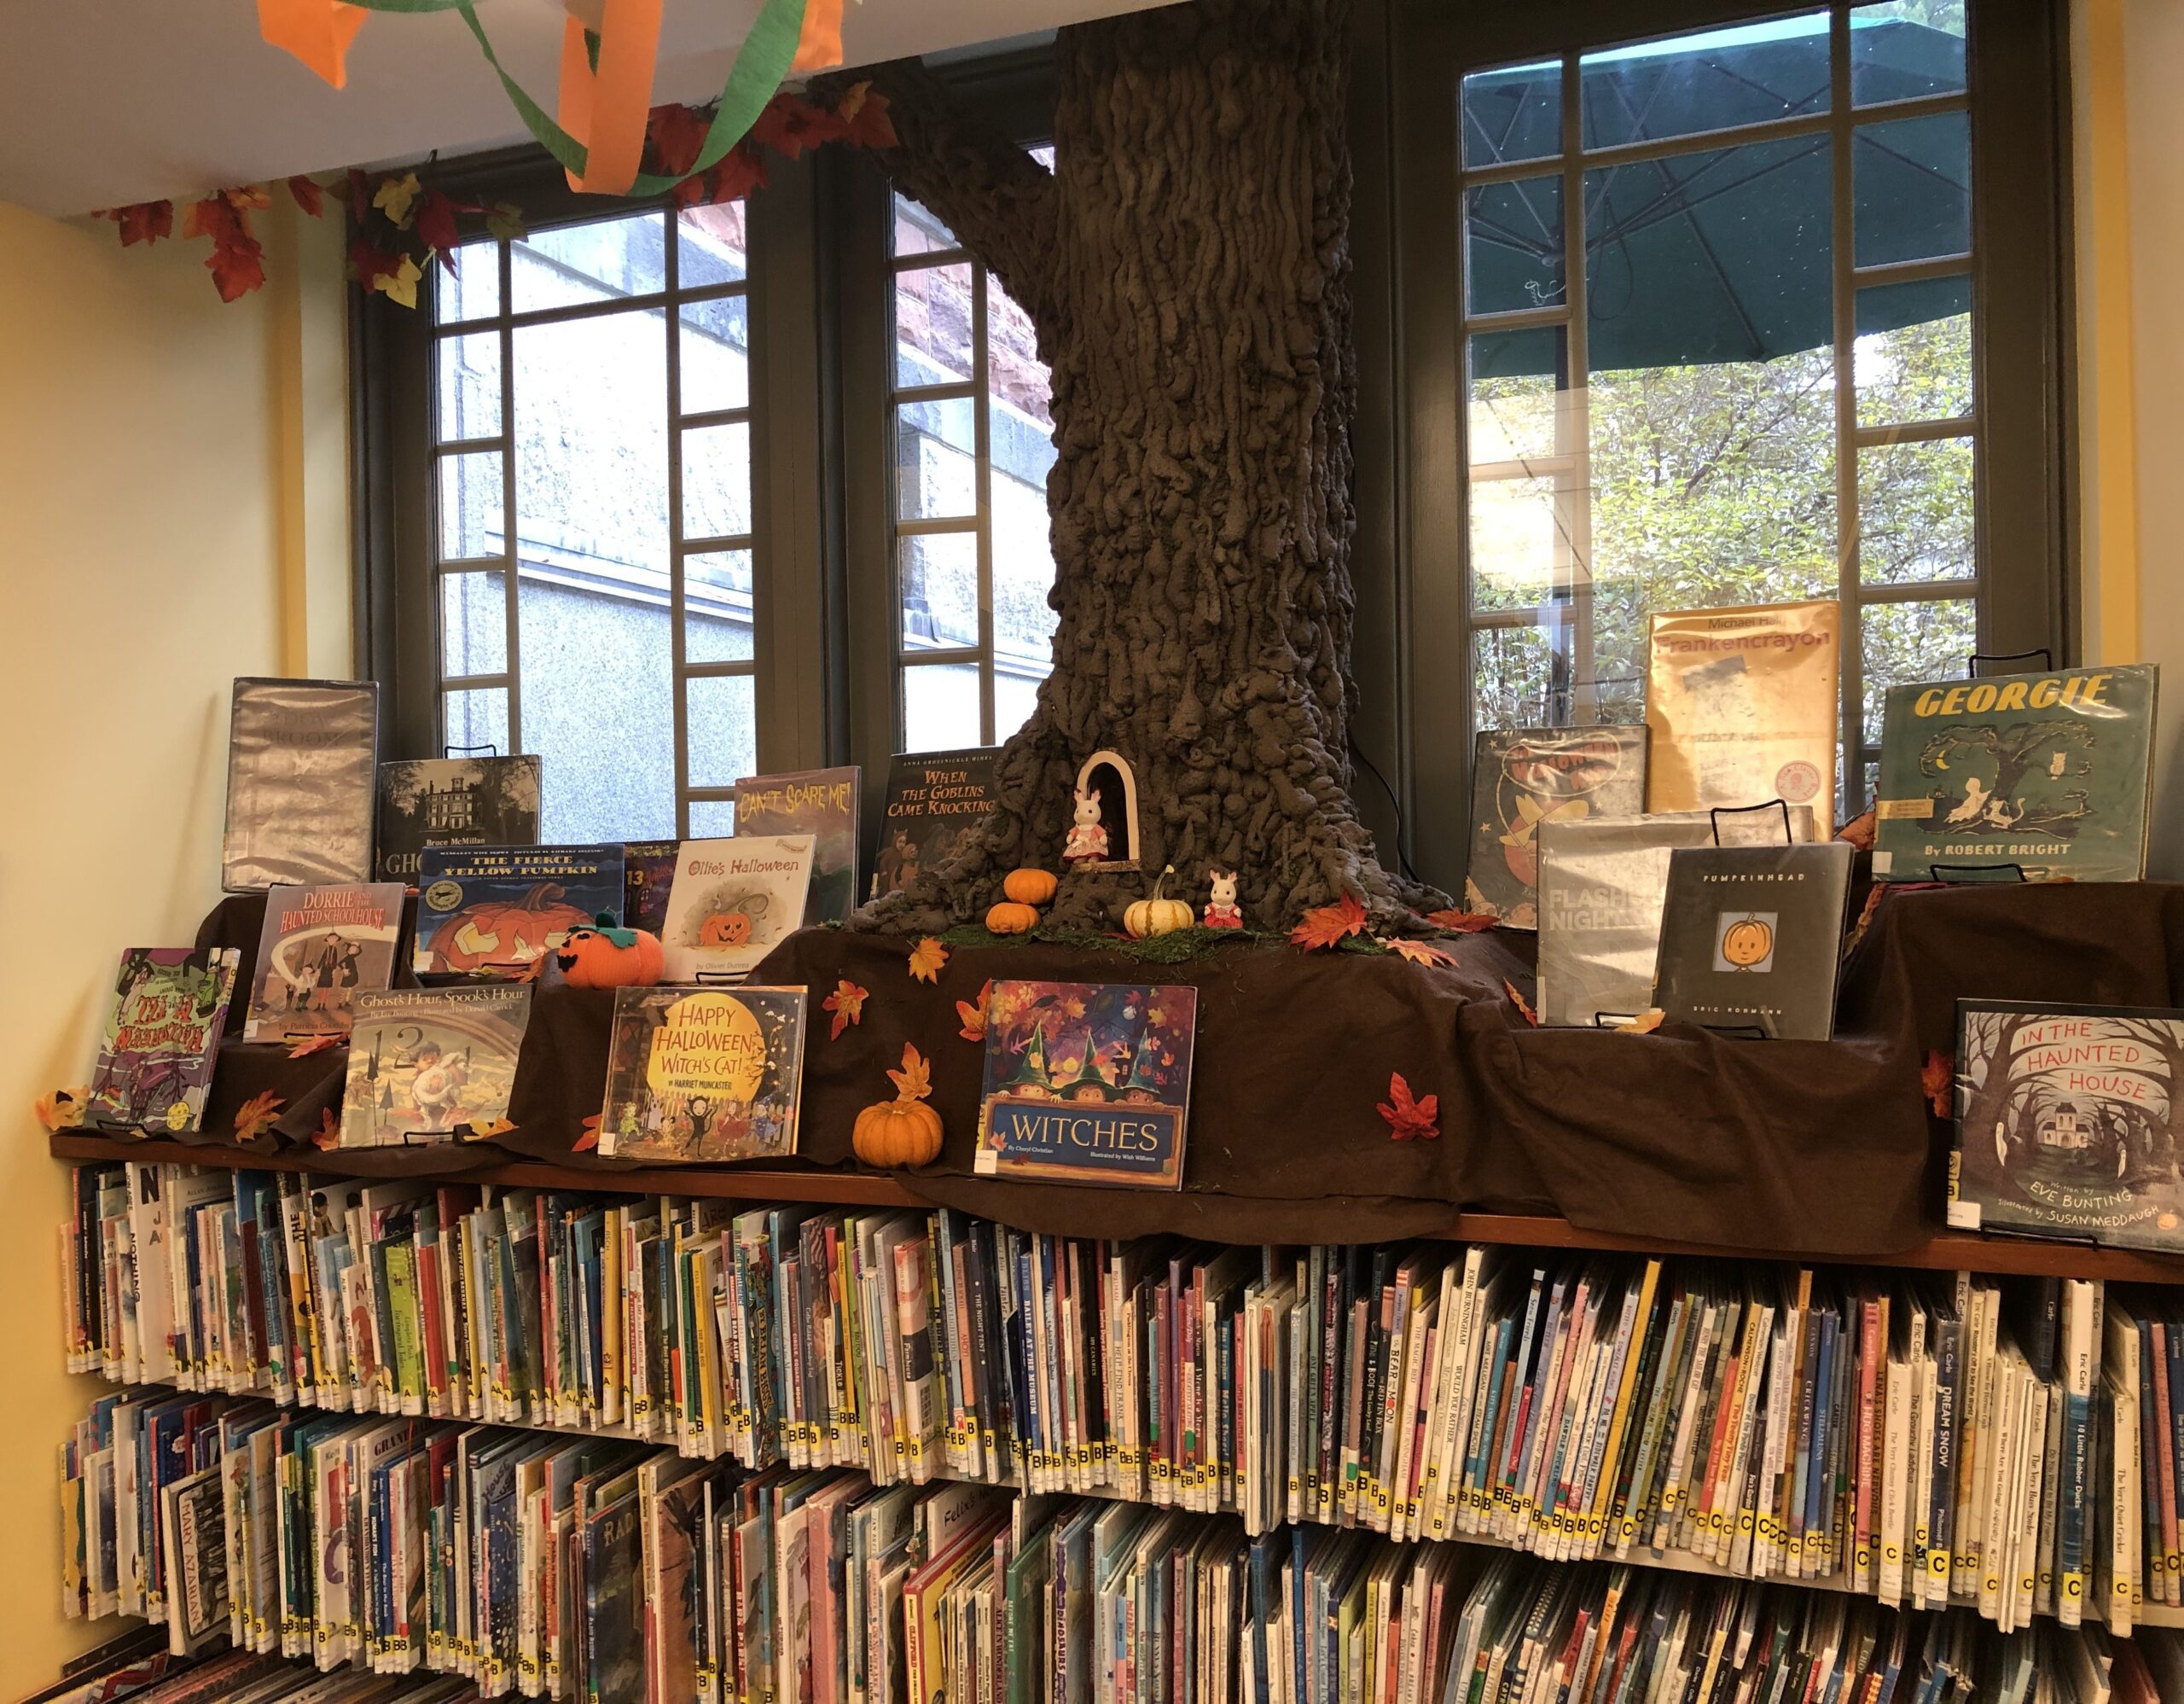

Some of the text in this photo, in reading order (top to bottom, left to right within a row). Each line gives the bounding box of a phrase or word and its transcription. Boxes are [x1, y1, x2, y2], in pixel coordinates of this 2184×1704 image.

[1708, 617, 1755, 629] Michael
[1656, 631, 1830, 653] Frankencrayon
[1914, 674, 2114, 718] GEORGIE
[924, 771, 967, 784] WHEN
[785, 783, 826, 814] SCARE
[828, 782, 851, 814] ME!
[902, 785, 985, 801] THE GOBLINS
[887, 800, 996, 817] CAME KNOCKING
[471, 857, 508, 865] THE
[1925, 844, 2071, 857] By ROBERT BRIGHT
[444, 865, 597, 876] YELLOW PUMPKIN
[627, 870, 643, 885] 13
[688, 860, 725, 876] Ollie's
[730, 858, 799, 875] Halloween
[1703, 874, 1805, 882] PUMPKINHEAD
[304, 891, 355, 909] DORRIE
[280, 908, 386, 933] HAUNTED SCHOOLHOUSE
[361, 988, 525, 1008] Ghost's Hour, Spook's Hour
[678, 1002, 736, 1027] HAPPY
[2022, 1022, 2094, 1044] IN THE
[662, 1053, 742, 1075] WITCH'S CAT!
[2027, 1044, 2140, 1072] HAUNTED
[675, 1079, 698, 1089] HARRIET
[699, 1080, 732, 1090] MUNCASTER
[2070, 1073, 2148, 1100] HOUSE
[1011, 1114, 1158, 1151] WITCHES
[2030, 1180, 2133, 1210] EVE BUNTING
[2036, 1210, 2044, 1218] by
[2046, 1210, 2088, 1225] SUSAN
[2092, 1205, 2159, 1227] MEDDAUGH
[130, 1233, 140, 1303] NOTHING
[1026, 1338, 1033, 1348] AT
[1449, 1268, 1475, 1414] JOHN BURNINGHAM WOULD YOU
[903, 1342, 912, 1379] Farmhouse
[1389, 1350, 1400, 1378] BEAR
[759, 1372, 774, 1408] BIGGS
[1028, 1374, 1037, 1415] MUSEUM
[1723, 1322, 1756, 1464] CALMENSON ROCHE The Teeny Tiny
[1745, 1393, 1756, 1412] Dinner
[1800, 1381, 1813, 1440] CRICKWING
[967, 1422, 974, 1434] B
[1815, 1409, 1827, 1461] STELLALUNA
[1936, 1337, 1955, 1540] Eric Carle DREAM SNOW Philomel
[2074, 1353, 2088, 1509] Eric Carle 10 Little Rubber Ducks
[912, 1444, 918, 1456] B
[1739, 1433, 1749, 1451] Panda
[1861, 1407, 1873, 1489] HUG MACHINE
[1735, 1452, 1746, 1471] Palace
[1745, 1474, 1757, 1509] Fox's Garden
[2116, 1468, 2127, 1554] The Very Quiet Cricket
[1589, 1520, 1600, 1534] C
[1741, 1516, 1751, 1530] C
[181, 1503, 200, 1622] MARY AZARIAN
[1886, 1547, 1897, 1559] C
[1933, 1556, 1945, 1572] C
[2068, 1580, 2081, 1596] C
[996, 1634, 1002, 1643] IN
